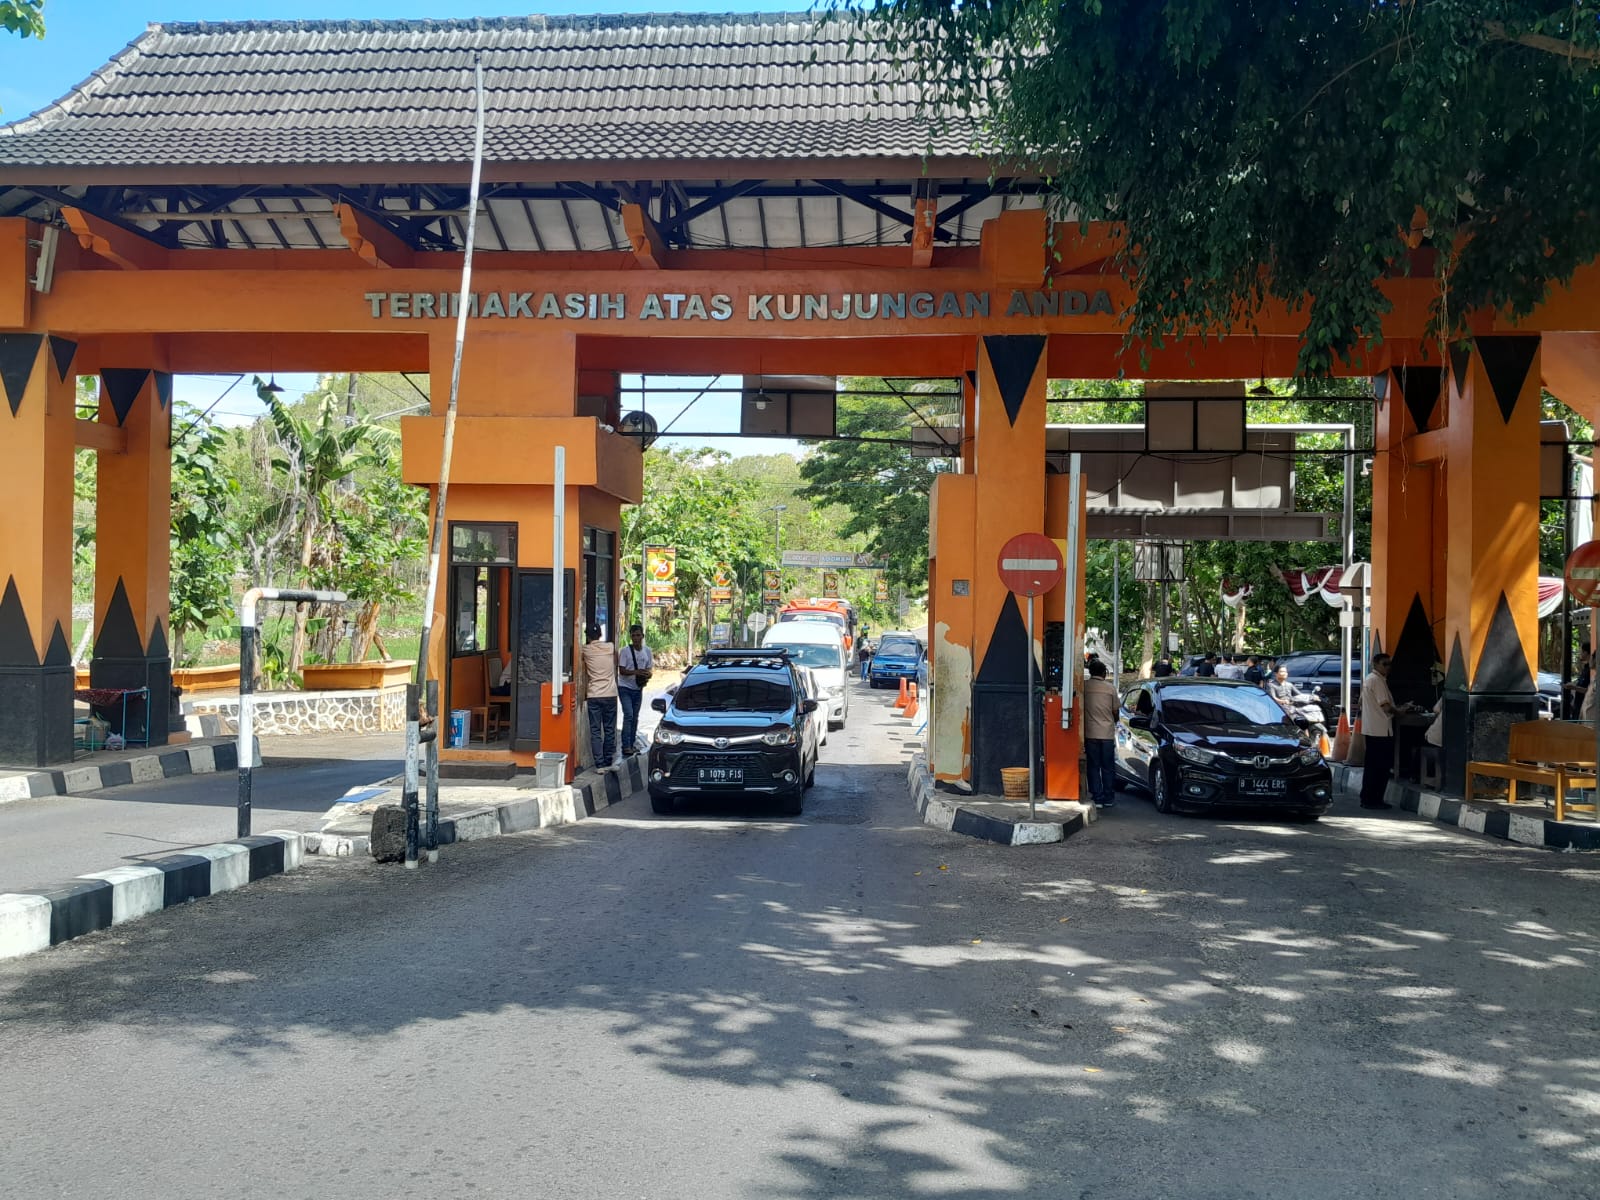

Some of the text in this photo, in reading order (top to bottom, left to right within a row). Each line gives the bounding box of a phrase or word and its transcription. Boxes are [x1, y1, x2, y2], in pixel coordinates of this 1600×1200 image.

[364, 289, 1115, 321] TERIMAKASIH ATAS KUNJUNGAN ANDA
